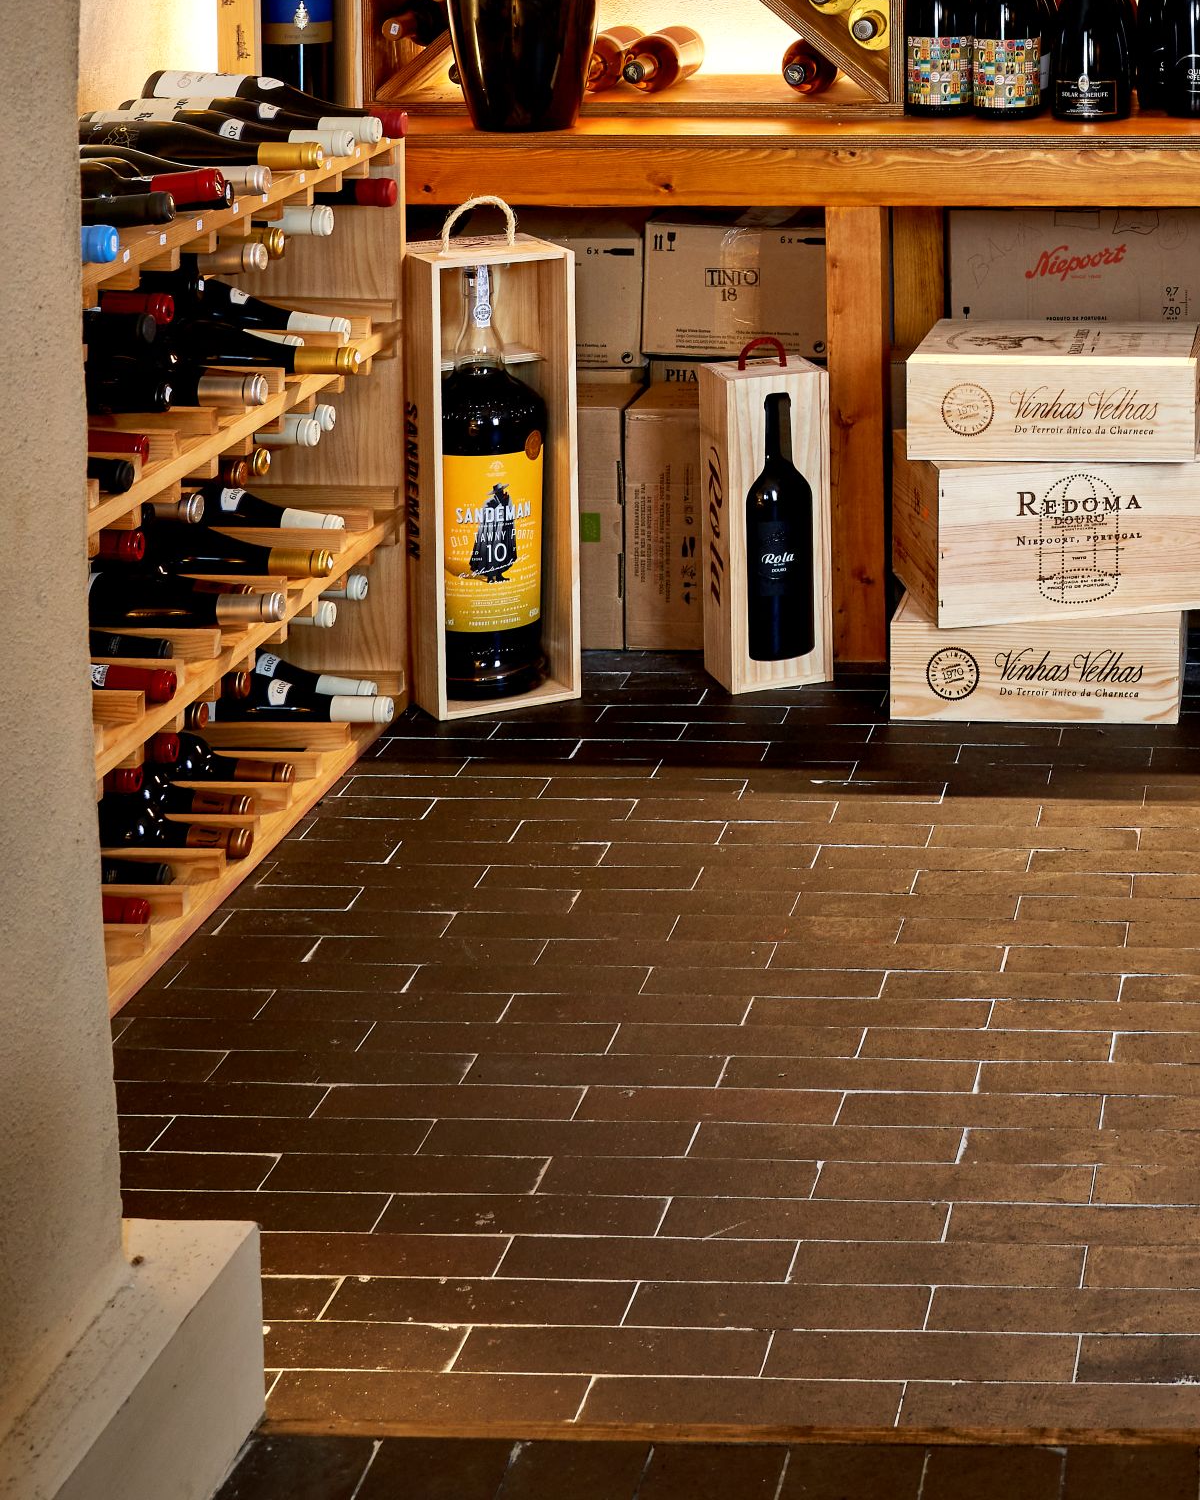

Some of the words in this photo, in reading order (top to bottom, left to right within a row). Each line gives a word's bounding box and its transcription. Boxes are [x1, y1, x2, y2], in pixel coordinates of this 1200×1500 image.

[780, 236, 786, 244] 6
[586, 247, 592, 255] 6
[1025, 243, 1127, 282] Niepoort
[707, 269, 760, 286] TINTO
[721, 288, 738, 302] 18
[1165, 286, 1179, 298] 9,7
[1162, 306, 1181, 317] 750
[1010, 386, 1085, 420] Vinhas
[1088, 386, 1159, 420] Velhas
[1014, 425, 1028, 434] Do
[1031, 425, 1063, 435] Terroir
[1094, 425, 1106, 435] da
[1109, 426, 1155, 436] Charneca
[405, 402, 420, 561] SANDEMAN
[1016, 490, 1142, 517] REDOMA
[455, 500, 531, 524] SANDEMAN
[707, 445, 725, 607] Rola
[1054, 514, 1105, 526] DOURO
[450, 535, 469, 548] OLD
[473, 530, 507, 544] TAWNY
[511, 528, 534, 540] PORTO
[1087, 532, 1143, 542] PORTUGAL
[486, 542, 508, 563] 10
[761, 551, 795, 565] Rola
[994, 648, 1071, 682] Vinhas
[1073, 648, 1144, 683] Velhas
[941, 667, 964, 681] 1970
[999, 687, 1013, 697] Do
[1016, 687, 1049, 697] Terroir
[1080, 688, 1091, 698] da
[1095, 688, 1140, 698] Charneca
